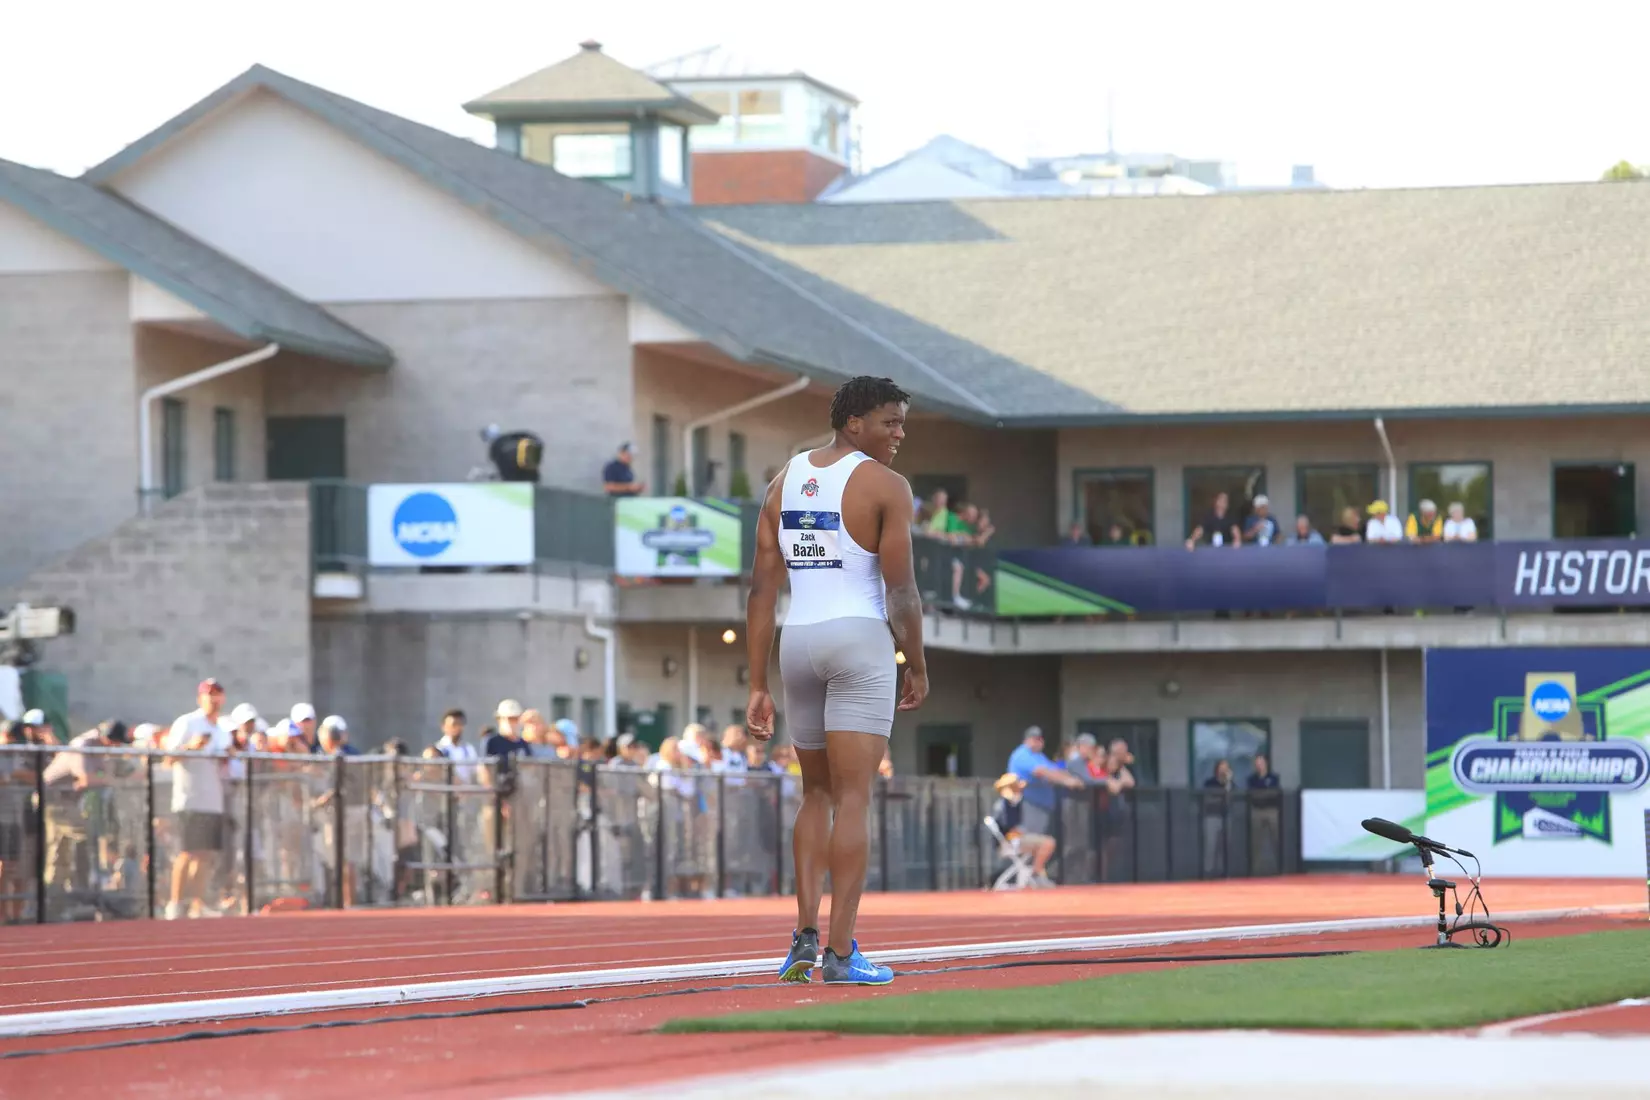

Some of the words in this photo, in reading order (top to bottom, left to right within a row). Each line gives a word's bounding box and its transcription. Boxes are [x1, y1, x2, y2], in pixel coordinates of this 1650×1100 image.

[800, 533, 815, 541] Zack
[793, 543, 826, 557] Bazile
[1514, 550, 1650, 596] HISTOR
[1470, 757, 1638, 784] CHAMPIONSHIPS
